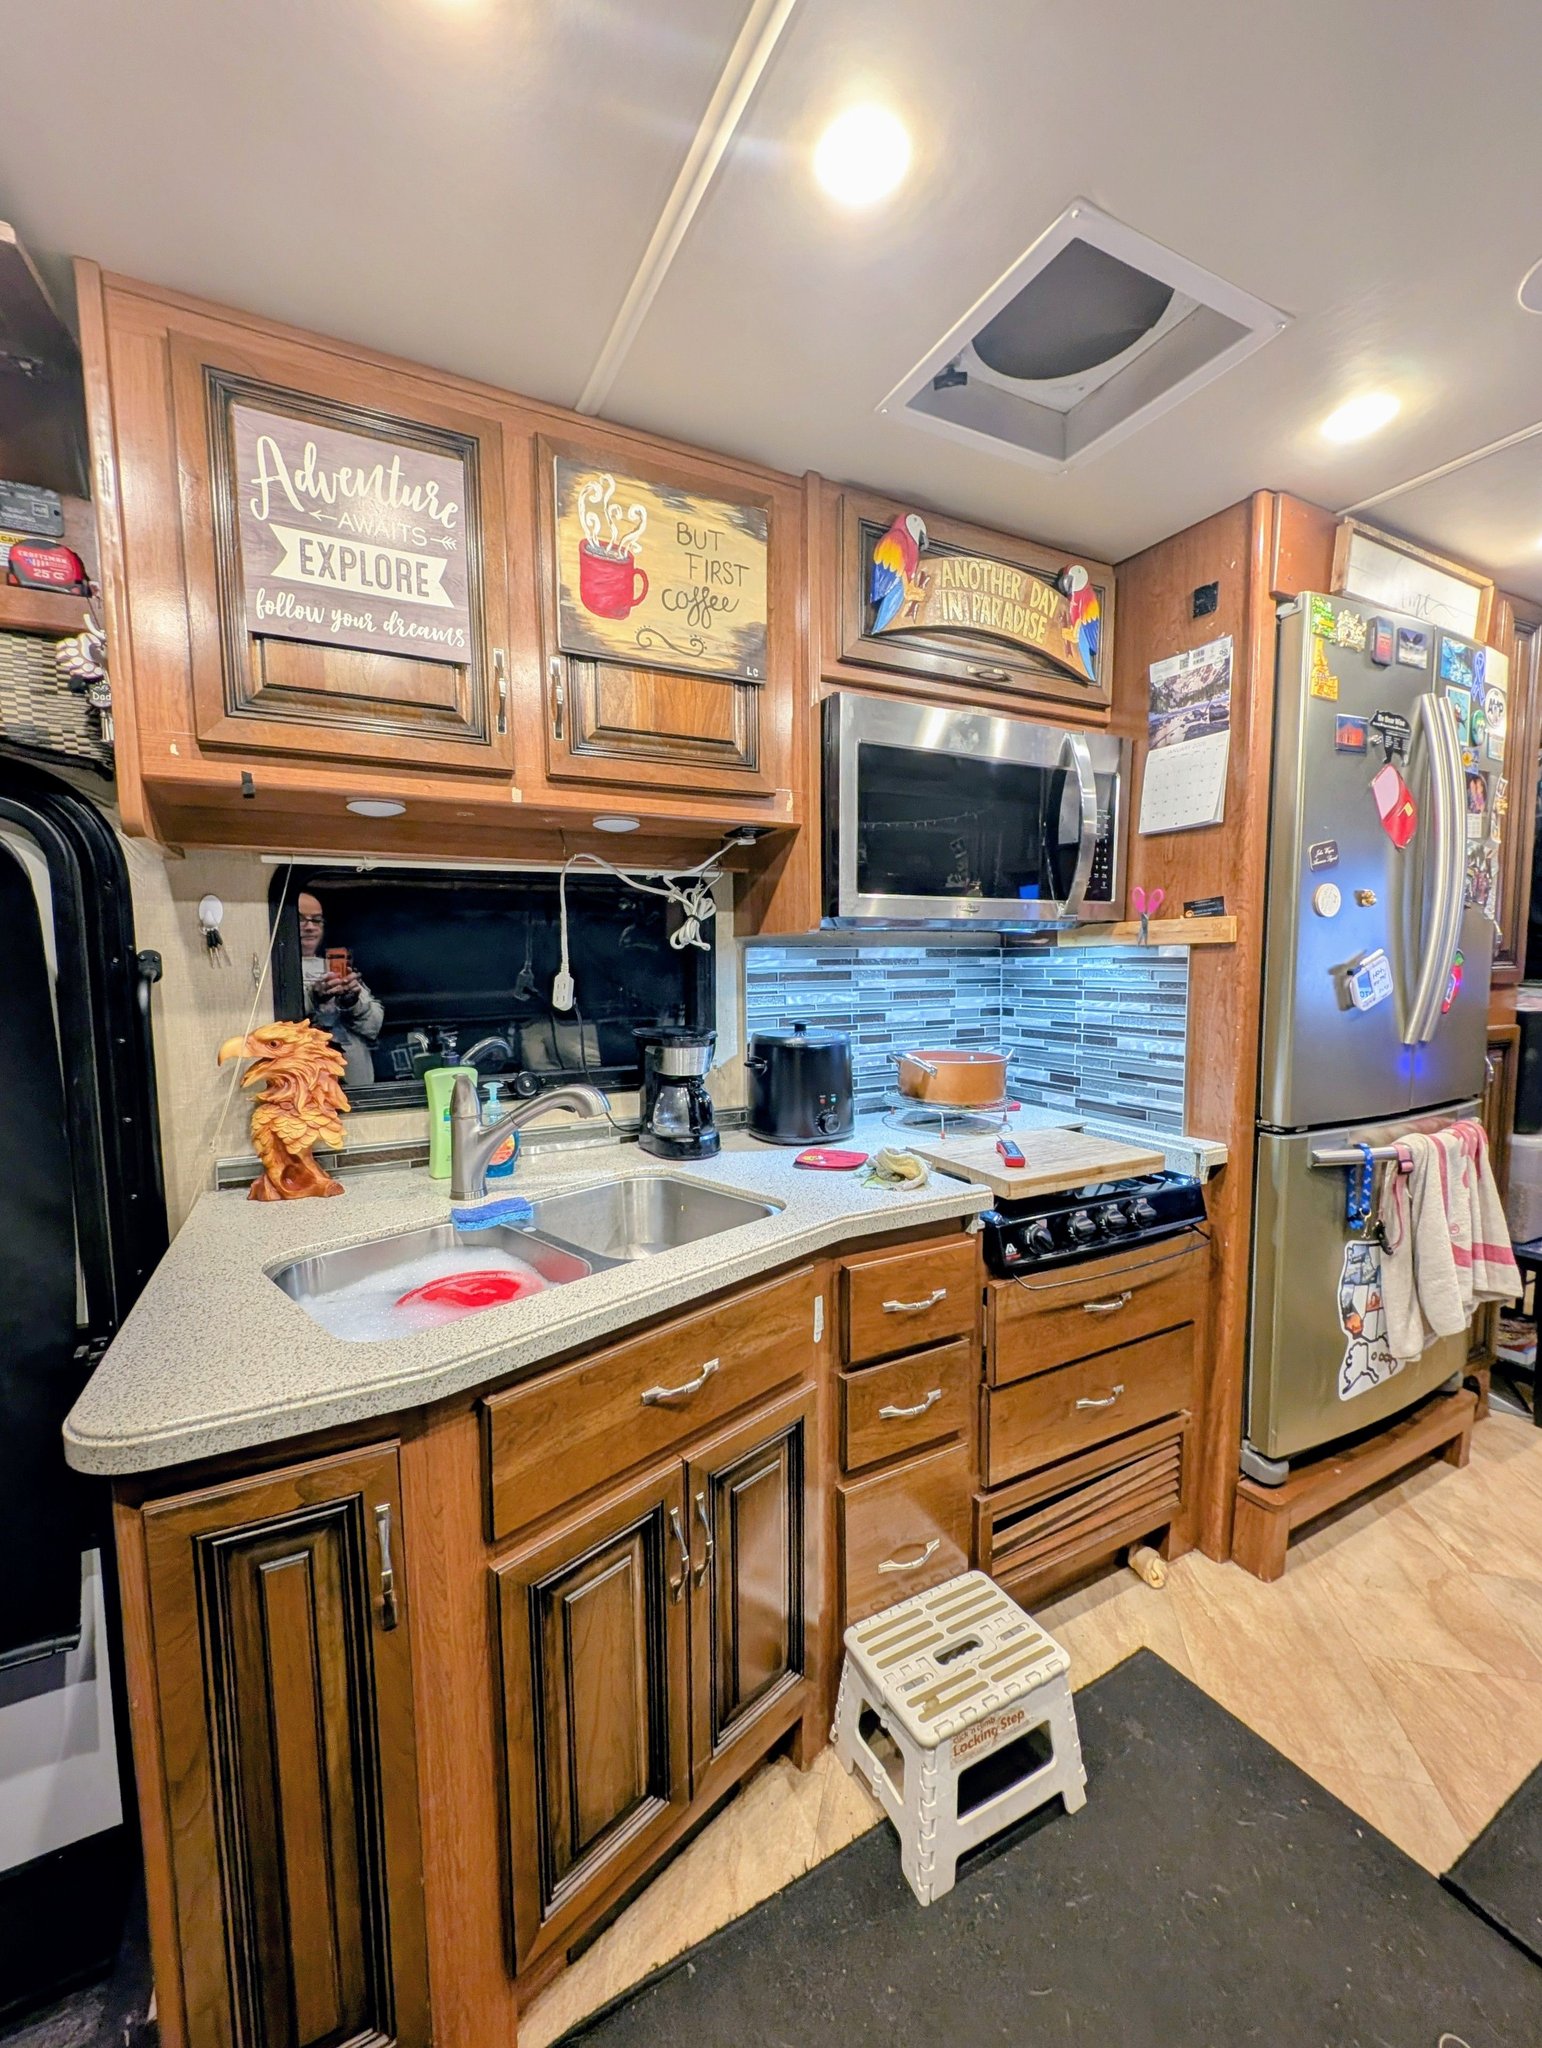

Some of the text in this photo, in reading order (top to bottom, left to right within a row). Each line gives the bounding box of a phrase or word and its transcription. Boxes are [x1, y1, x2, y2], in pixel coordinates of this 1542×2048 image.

[250, 435, 459, 529] Adventure
[337, 511, 428, 547] AWAITS
[676, 521, 725, 551] BUT
[299, 537, 430, 598] EXPLORE
[685, 552, 750, 587] FIRST
[941, 560, 1059, 618] ANOTHER DAY
[255, 587, 466, 648] follow your dreams
[940, 590, 1048, 645] IN PARADISE
[953, 1709, 1025, 1757] Locking Step
